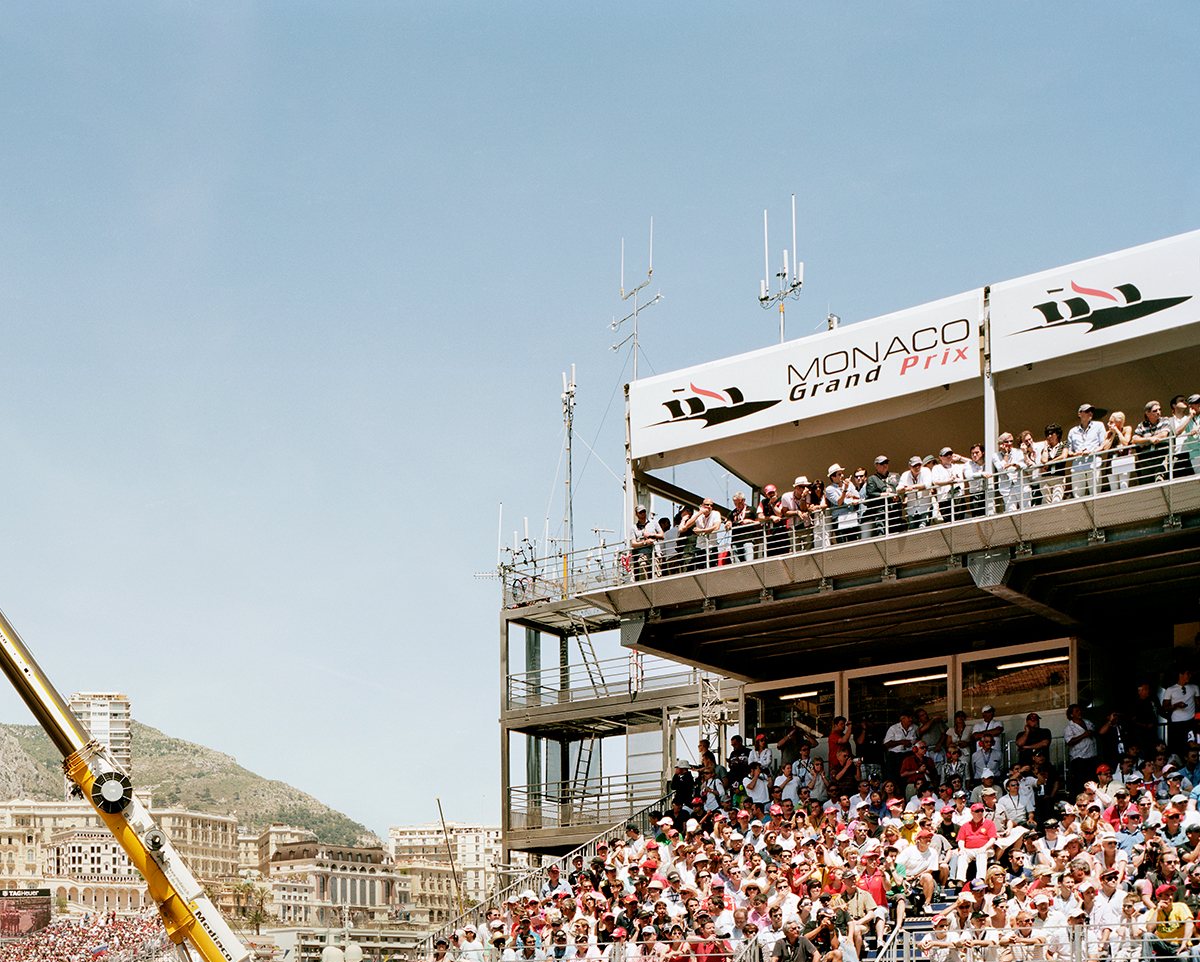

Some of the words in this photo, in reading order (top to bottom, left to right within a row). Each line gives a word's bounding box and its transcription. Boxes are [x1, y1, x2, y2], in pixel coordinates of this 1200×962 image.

[787, 318, 970, 385] MONACO
[789, 364, 882, 402] Grand
[899, 345, 969, 376] Prix
[195, 911, 233, 962] Mediaco
